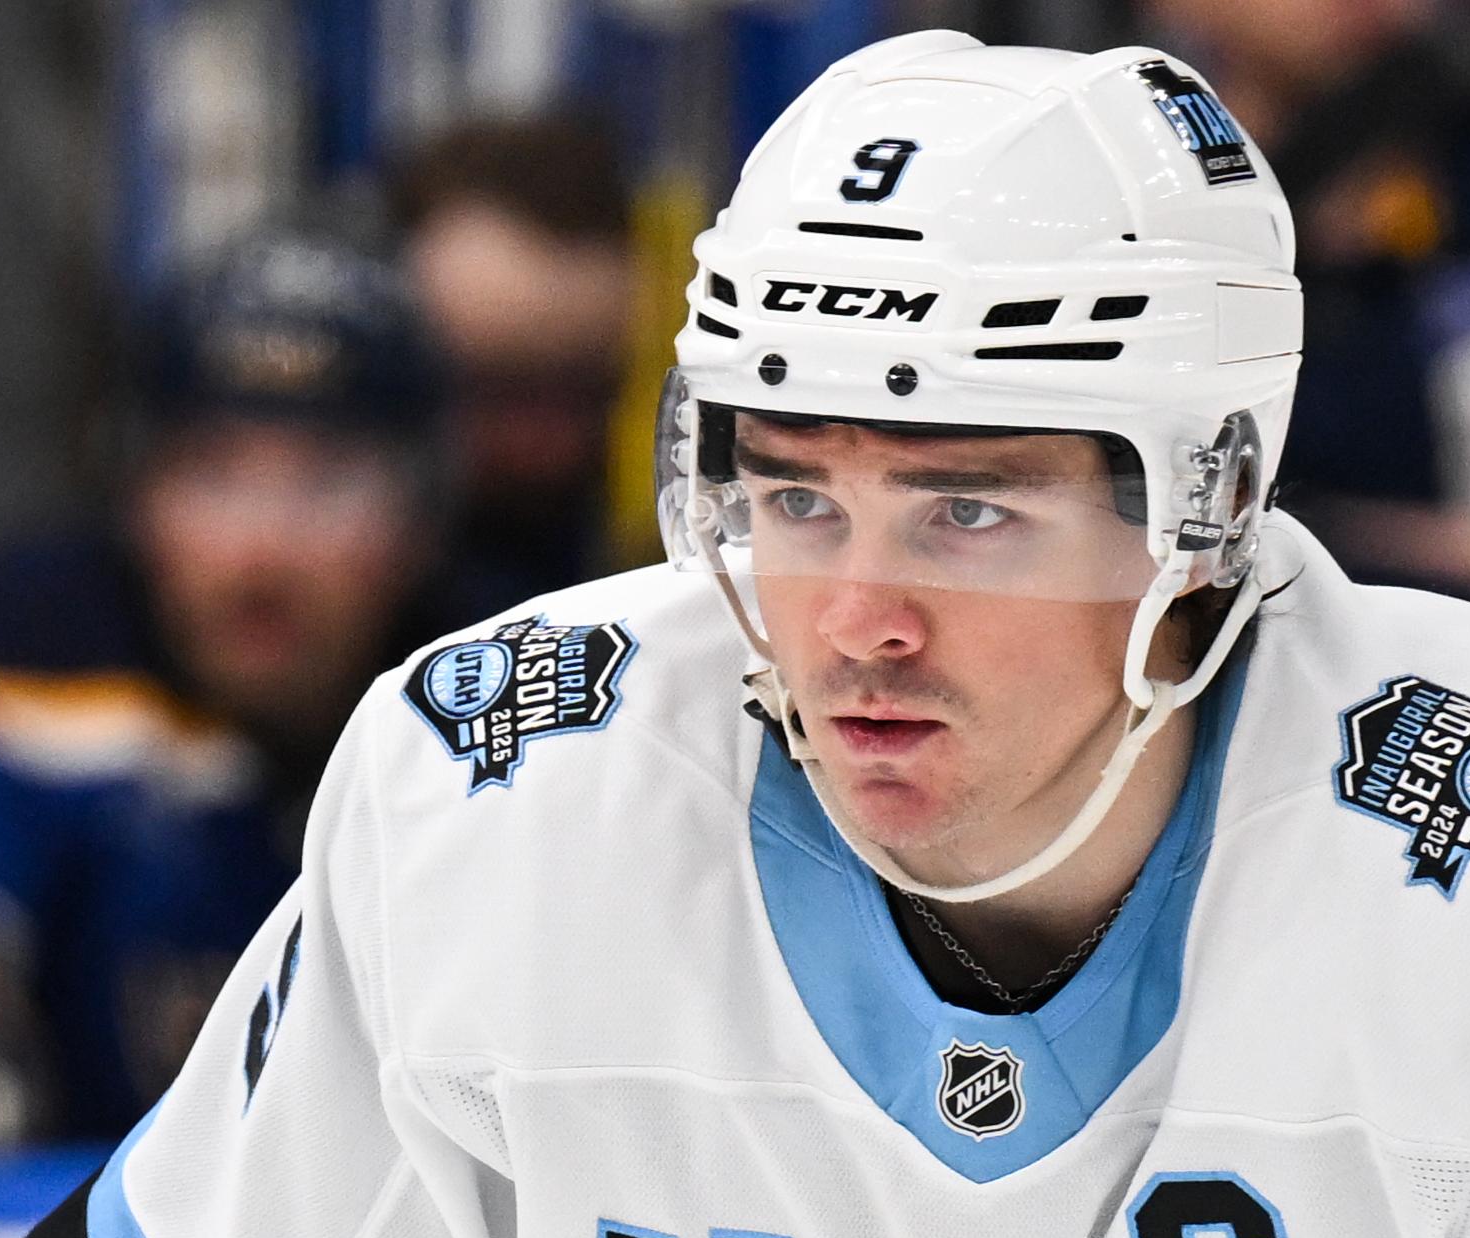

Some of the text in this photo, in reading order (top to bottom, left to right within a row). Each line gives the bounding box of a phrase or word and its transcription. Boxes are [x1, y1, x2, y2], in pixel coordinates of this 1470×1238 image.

[839, 136, 922, 205] 9
[762, 280, 939, 323] CCM
[454, 649, 484, 707] UTAH
[516, 627, 573, 731] SEASON
[491, 708, 512, 762] 2025
[1358, 688, 1447, 808] INAUGURAL
[1420, 804, 1461, 859] 2024
[956, 1069, 1007, 1115] NHL
